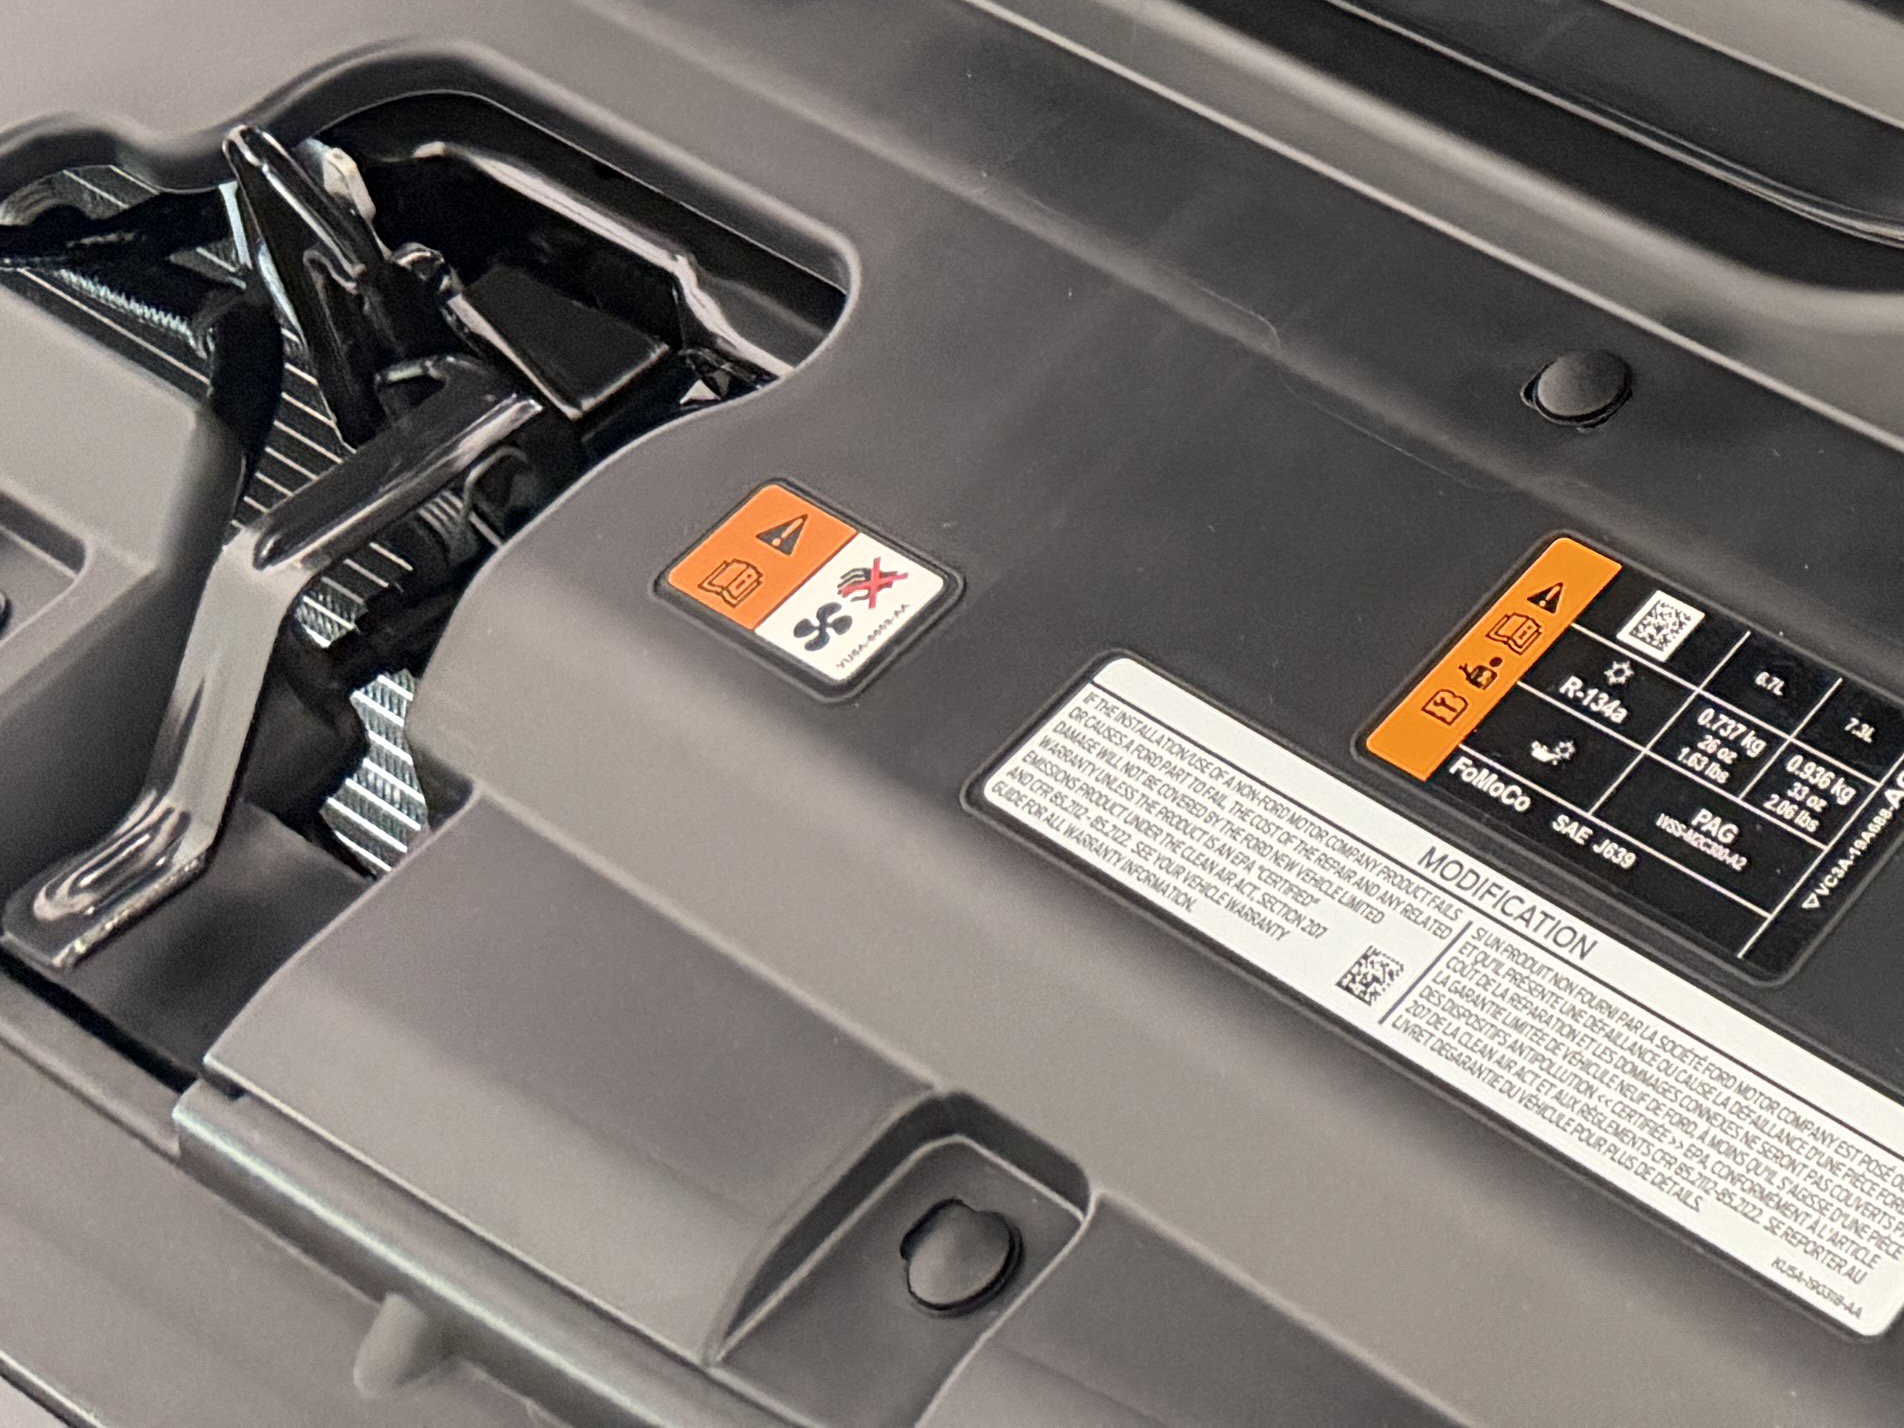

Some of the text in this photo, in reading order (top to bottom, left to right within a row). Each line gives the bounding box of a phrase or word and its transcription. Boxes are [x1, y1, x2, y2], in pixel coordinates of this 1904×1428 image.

[1561, 677, 1629, 722] R-134a
[1754, 670, 1788, 696] 6.7L
[1064, 704, 1091, 725] OR
[1079, 713, 1130, 748] CAUSES
[1697, 707, 1768, 757] 0.737 kg
[1845, 716, 1877, 742] 7.3L
[1118, 736, 1139, 754] A
[1127, 741, 1166, 770] FORD
[1697, 734, 1738, 765] 26 oz
[1155, 758, 1194, 786] PART
[1676, 746, 1732, 784] 1.63 lbs
[1786, 753, 1858, 805] 0.936 kg
[1183, 774, 1209, 795] TO
[1452, 758, 1531, 811] FoMoCo
[1785, 780, 1826, 812] 33 oz
[1033, 733, 1102, 779] WARRANTY
[1091, 767, 1141, 803] UNLESS
[1130, 791, 1162, 815] THE
[1152, 804, 1211, 845] PRODUCT
[1200, 833, 1222, 851] IS
[1211, 840, 1238, 861] AN
[1227, 849, 1259, 874] EPA
[1079, 690, 1466, 923] IF THE INSTALLATION/USE OF A NON-FORD MOTOR COMPANY PRODUCT FAILS
[1224, 799, 1257, 824] THE
[1764, 793, 1822, 832] 2.06 lbs
[987, 778, 1029, 808] GUIDE
[1018, 797, 1050, 821] FOR
[1039, 809, 1070, 833] ALL
[1058, 821, 1128, 869] WARRANTY
[1049, 719, 1388, 926] DAMAGE WILL NOT BE COVERED BY THE FORD NEW VEHICLE LIMITED
[1245, 811, 1285, 840] COST
[1273, 828, 1300, 849] OF
[1691, 808, 1739, 844] PAG
[1003, 763, 1036, 788] AND
[1025, 776, 1057, 800] CFR
[1127, 838, 1158, 862] SEE
[1147, 851, 1188, 881] YOUR
[1177, 869, 1232, 907] VEHICLE
[1220, 894, 1292, 944] WARRANTY
[1019, 748, 1083, 792] EMISSIONS
[1071, 780, 1130, 820] PRODUCT
[1119, 809, 1167, 842] UNDER
[1155, 830, 1188, 855] THE
[1176, 843, 1221, 875] CLEAN
[1210, 863, 1240, 887] AIR
[1253, 890, 1309, 929] SECTION
[1298, 916, 1330, 941] 207
[1289, 837, 1321, 862] THE
[1551, 813, 1636, 868] SAE J639
[1310, 850, 1360, 885] REPAIR
[1349, 872, 1384, 899] AND
[1373, 887, 1407, 913] ANY
[1417, 844, 1599, 962] MODIFICATION
[1396, 900, 1456, 942] RELATED
